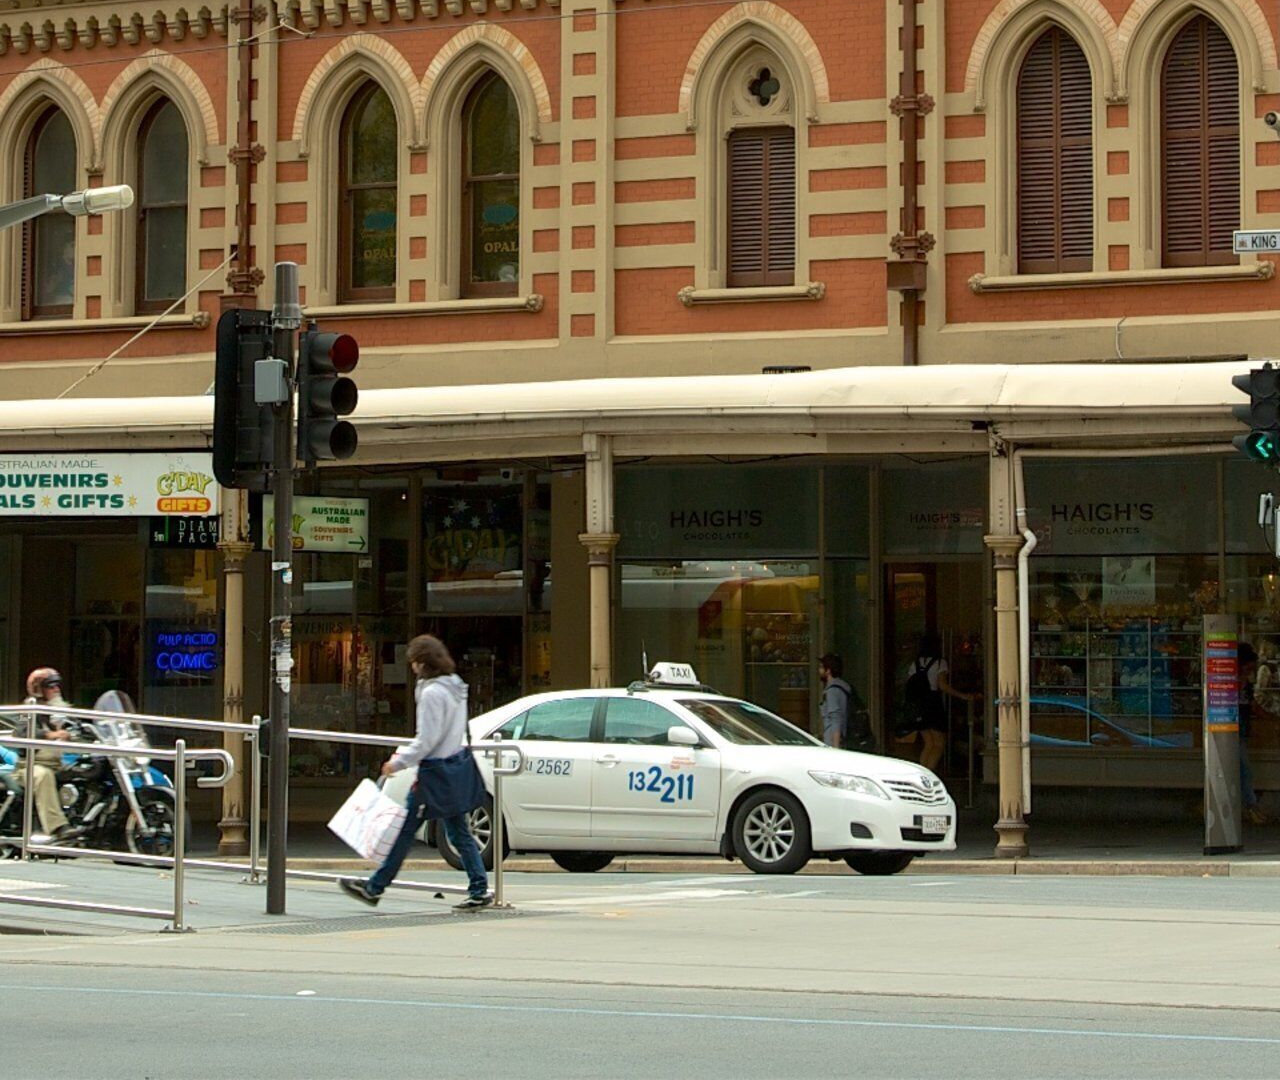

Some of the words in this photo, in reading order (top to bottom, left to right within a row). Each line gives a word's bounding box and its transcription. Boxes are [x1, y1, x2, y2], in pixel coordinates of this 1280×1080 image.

[1251, 235, 1277, 248] KING
[58, 494, 124, 508] GIFTS
[161, 499, 207, 511] GIFTS
[312, 507, 365, 517] AUSTRALIAN
[1051, 503, 1154, 522] HAIGH'S
[326, 516, 351, 524] MADE
[671, 509, 762, 528] HAIGH'S
[313, 526, 353, 534] SOUVENIRS
[1067, 526, 1140, 536] CHOCOLATES
[684, 532, 751, 541] CHOCOLATES
[158, 633, 182, 646] PULP
[670, 667, 691, 678] TAXI
[536, 759, 570, 776] 2562
